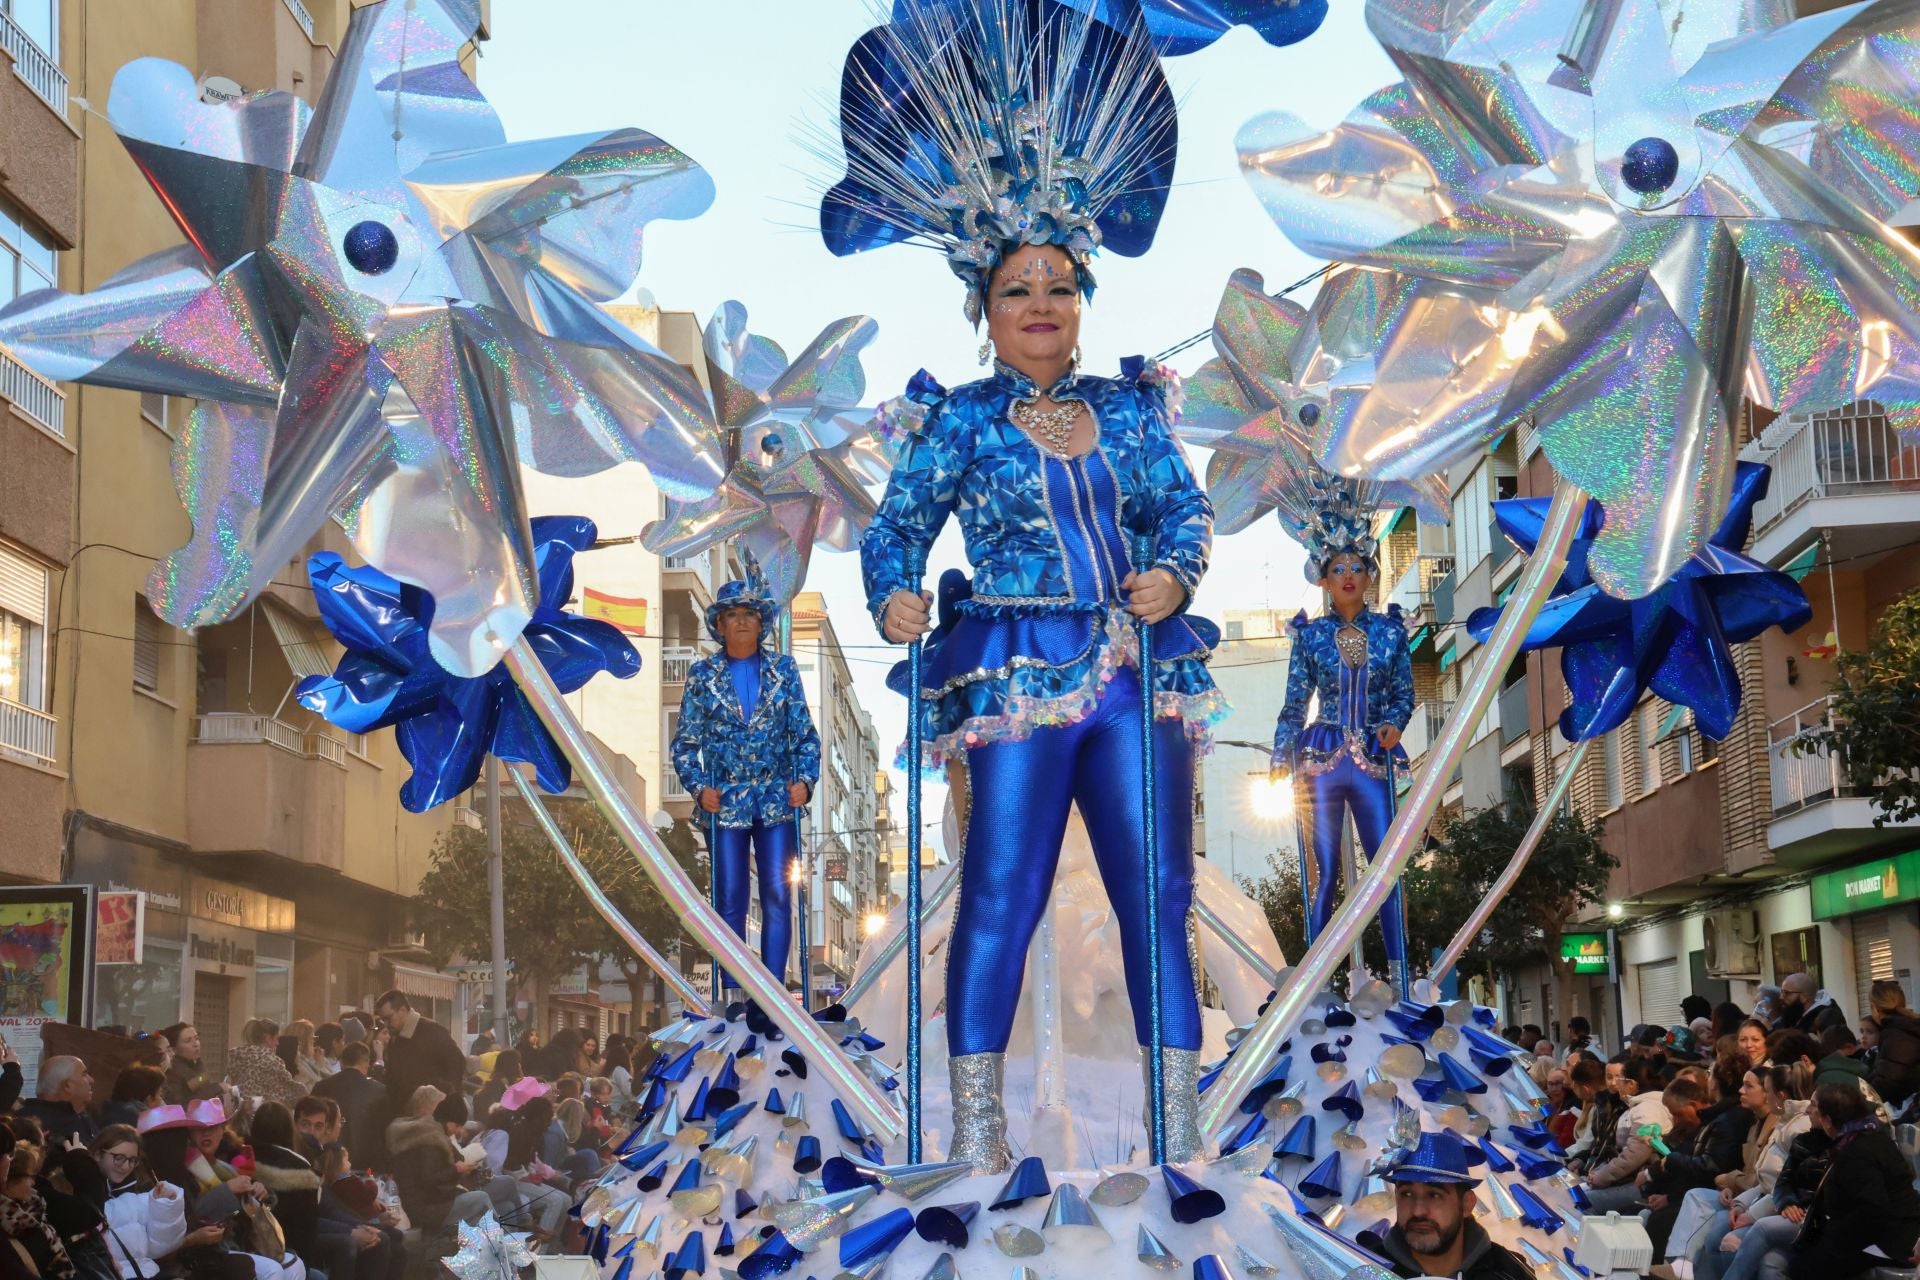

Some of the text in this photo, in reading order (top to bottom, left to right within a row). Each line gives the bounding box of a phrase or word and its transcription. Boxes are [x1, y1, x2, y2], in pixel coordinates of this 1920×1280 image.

[1845, 875, 1881, 898] DON MARKET
[207, 889, 244, 915] GESTORÍA
[0, 1018, 21, 1026] VAL
